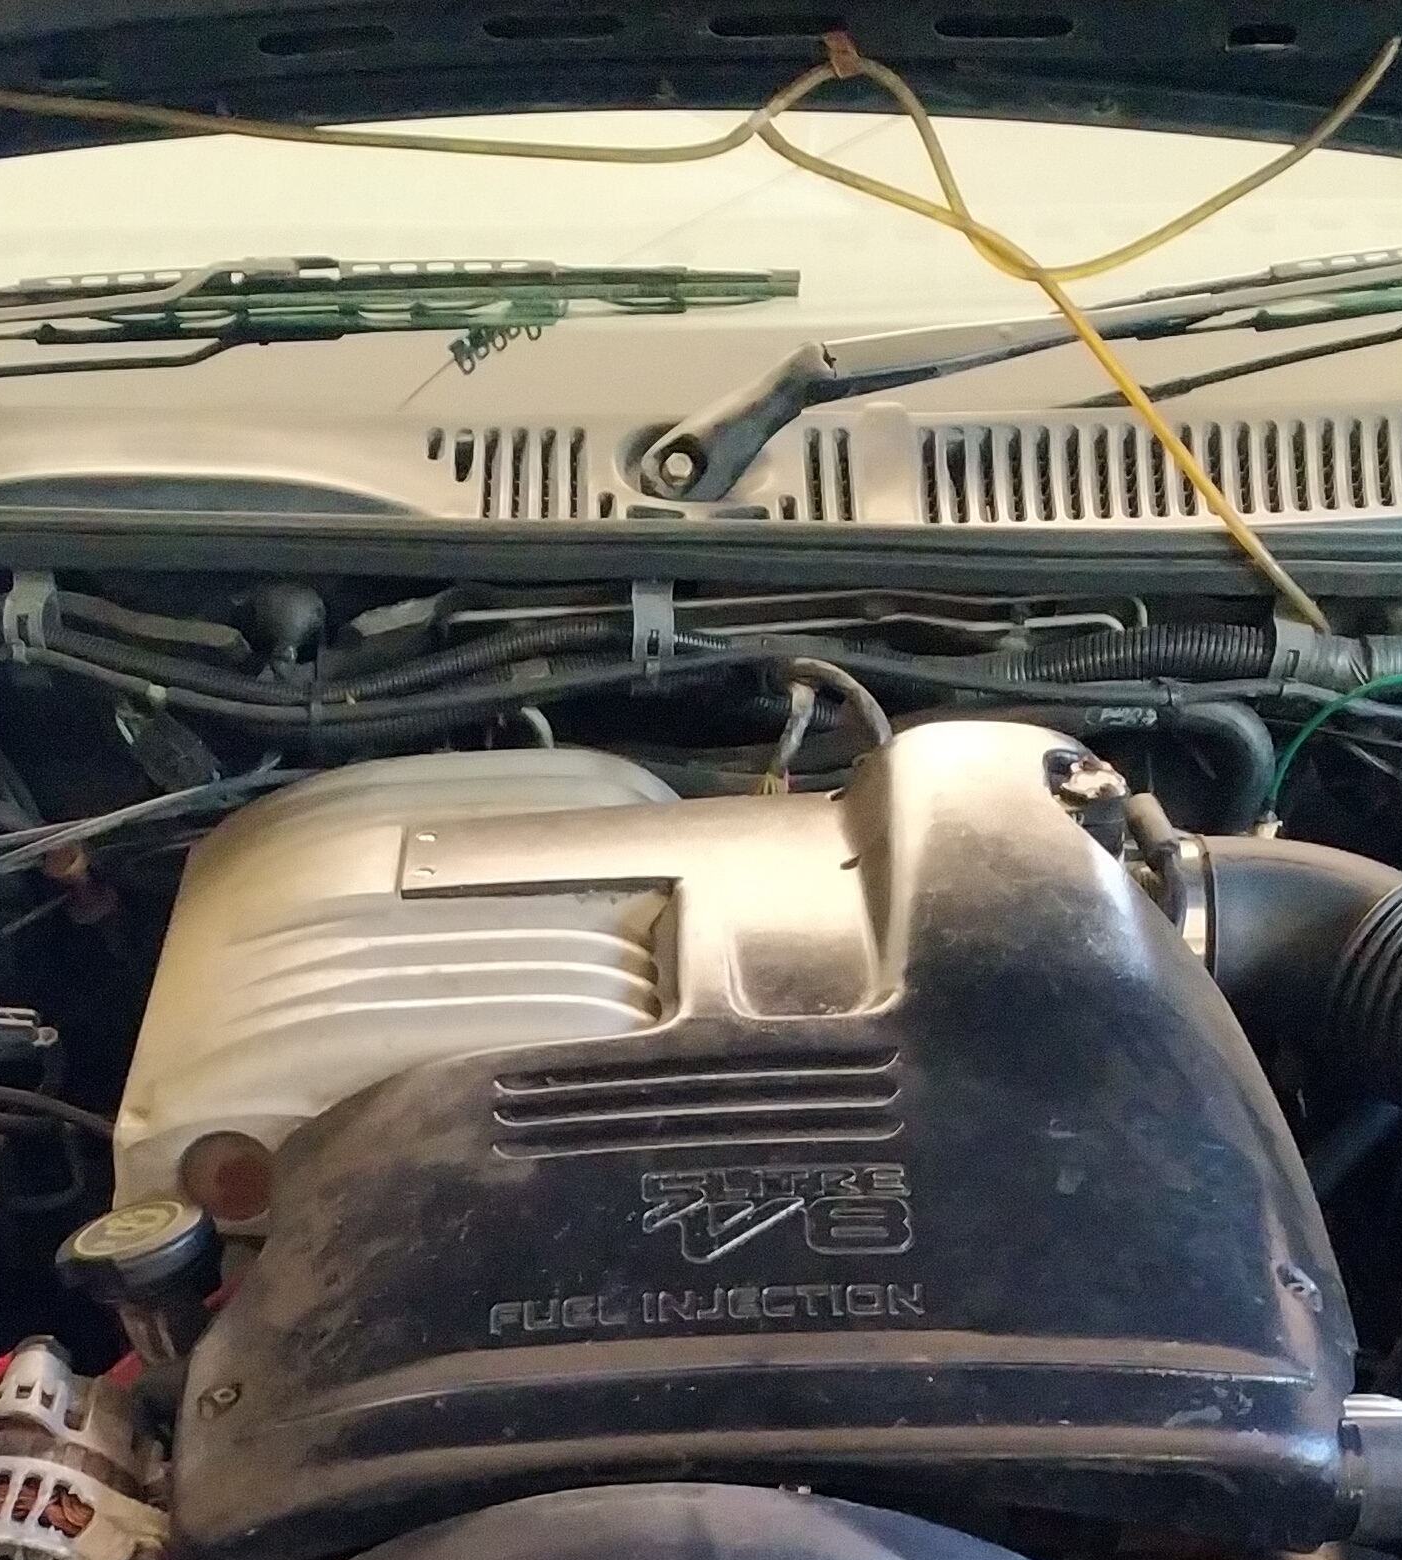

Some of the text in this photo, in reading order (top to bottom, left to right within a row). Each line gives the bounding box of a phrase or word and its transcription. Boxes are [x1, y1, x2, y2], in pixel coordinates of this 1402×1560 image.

[679, 1196, 914, 1263] V8
[489, 1282, 925, 1336] FUEL INJECTION
